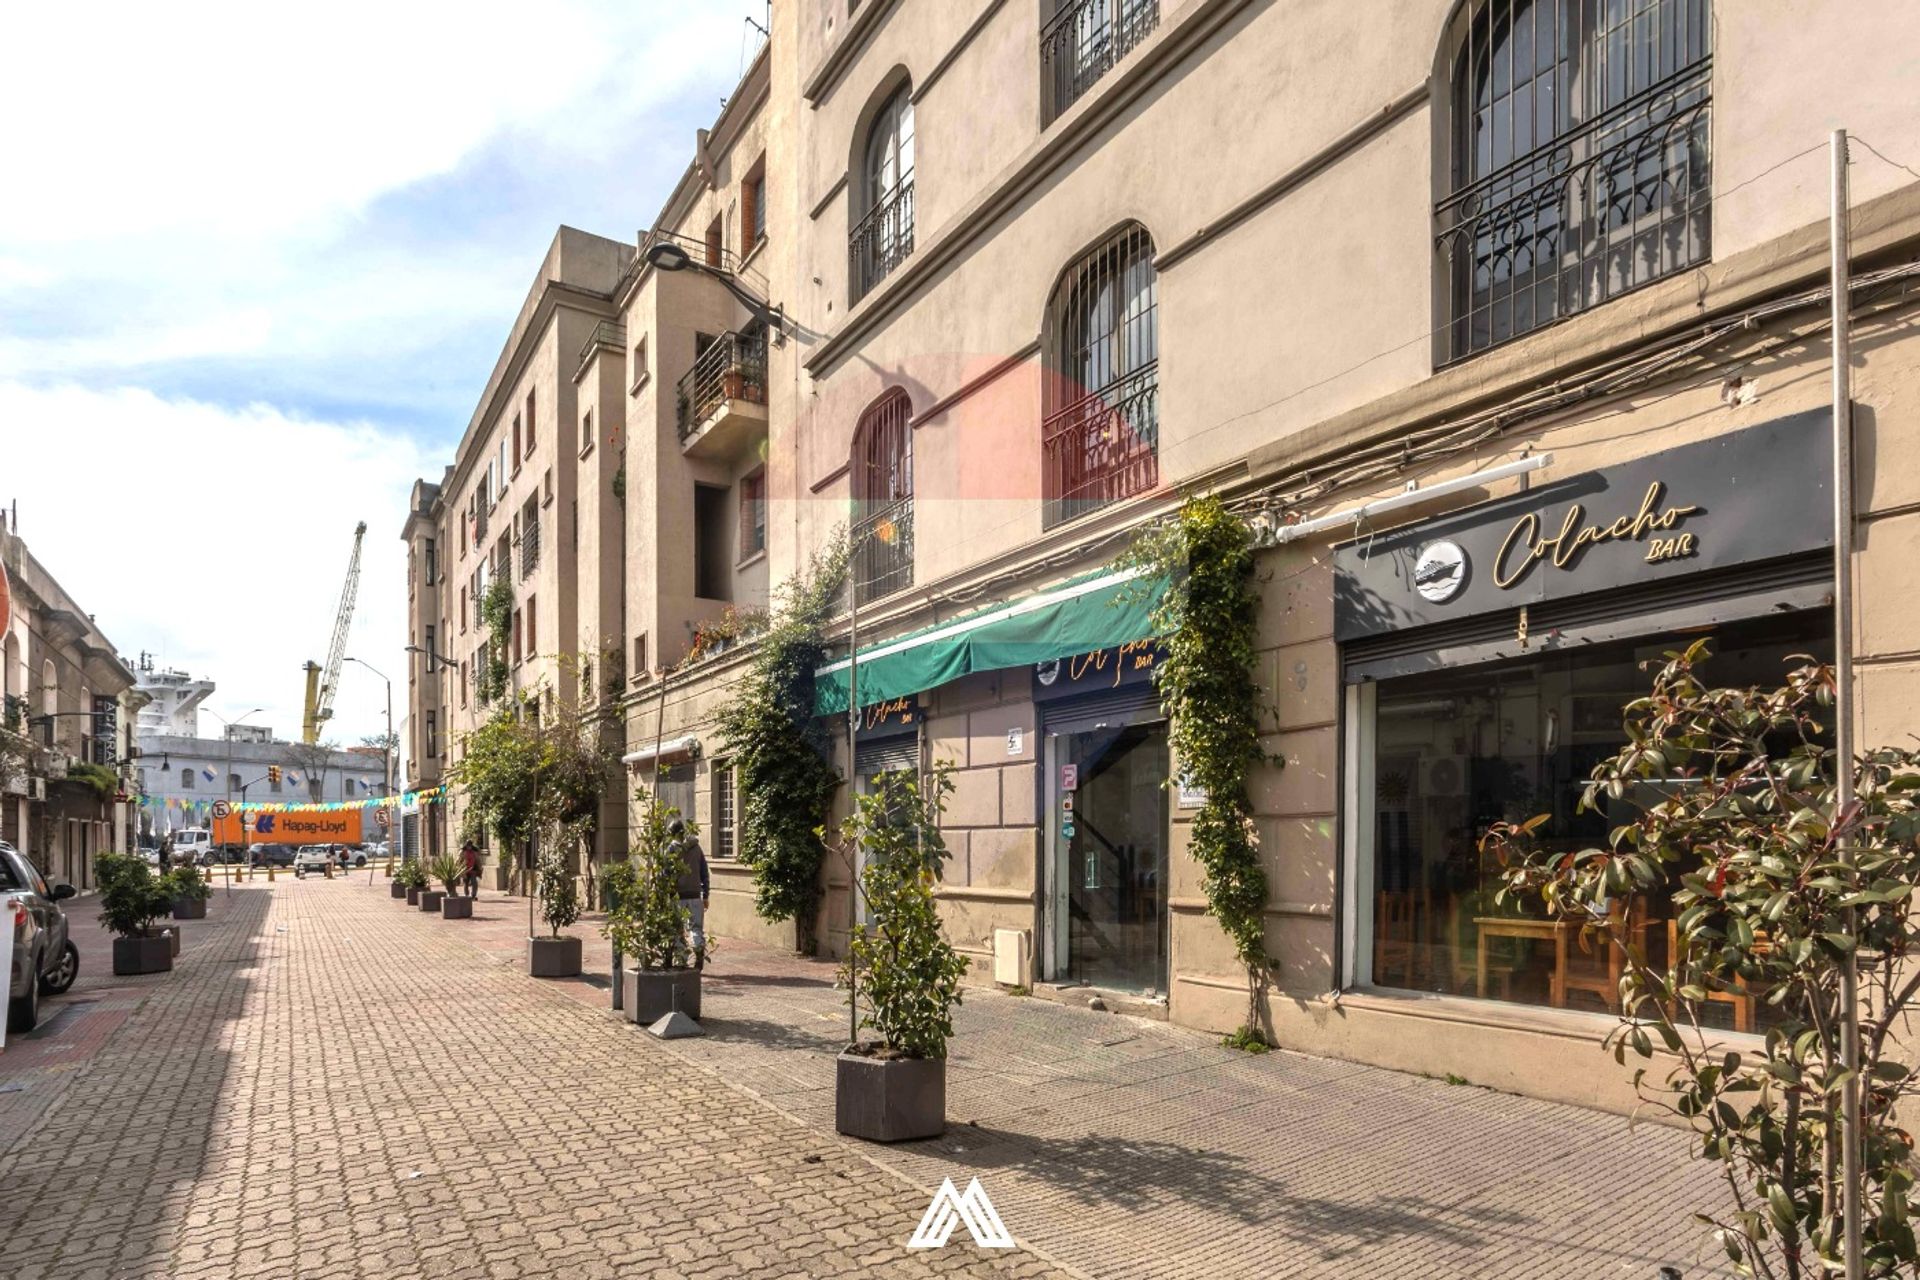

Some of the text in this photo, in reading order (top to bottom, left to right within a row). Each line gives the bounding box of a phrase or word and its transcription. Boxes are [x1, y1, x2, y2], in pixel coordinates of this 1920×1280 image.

[1493, 480, 1697, 588] Colacho
[1645, 533, 1693, 562] BAR
[1134, 653, 1154, 669] BAR
[282, 819, 347, 834] Hapag-Lloyd
